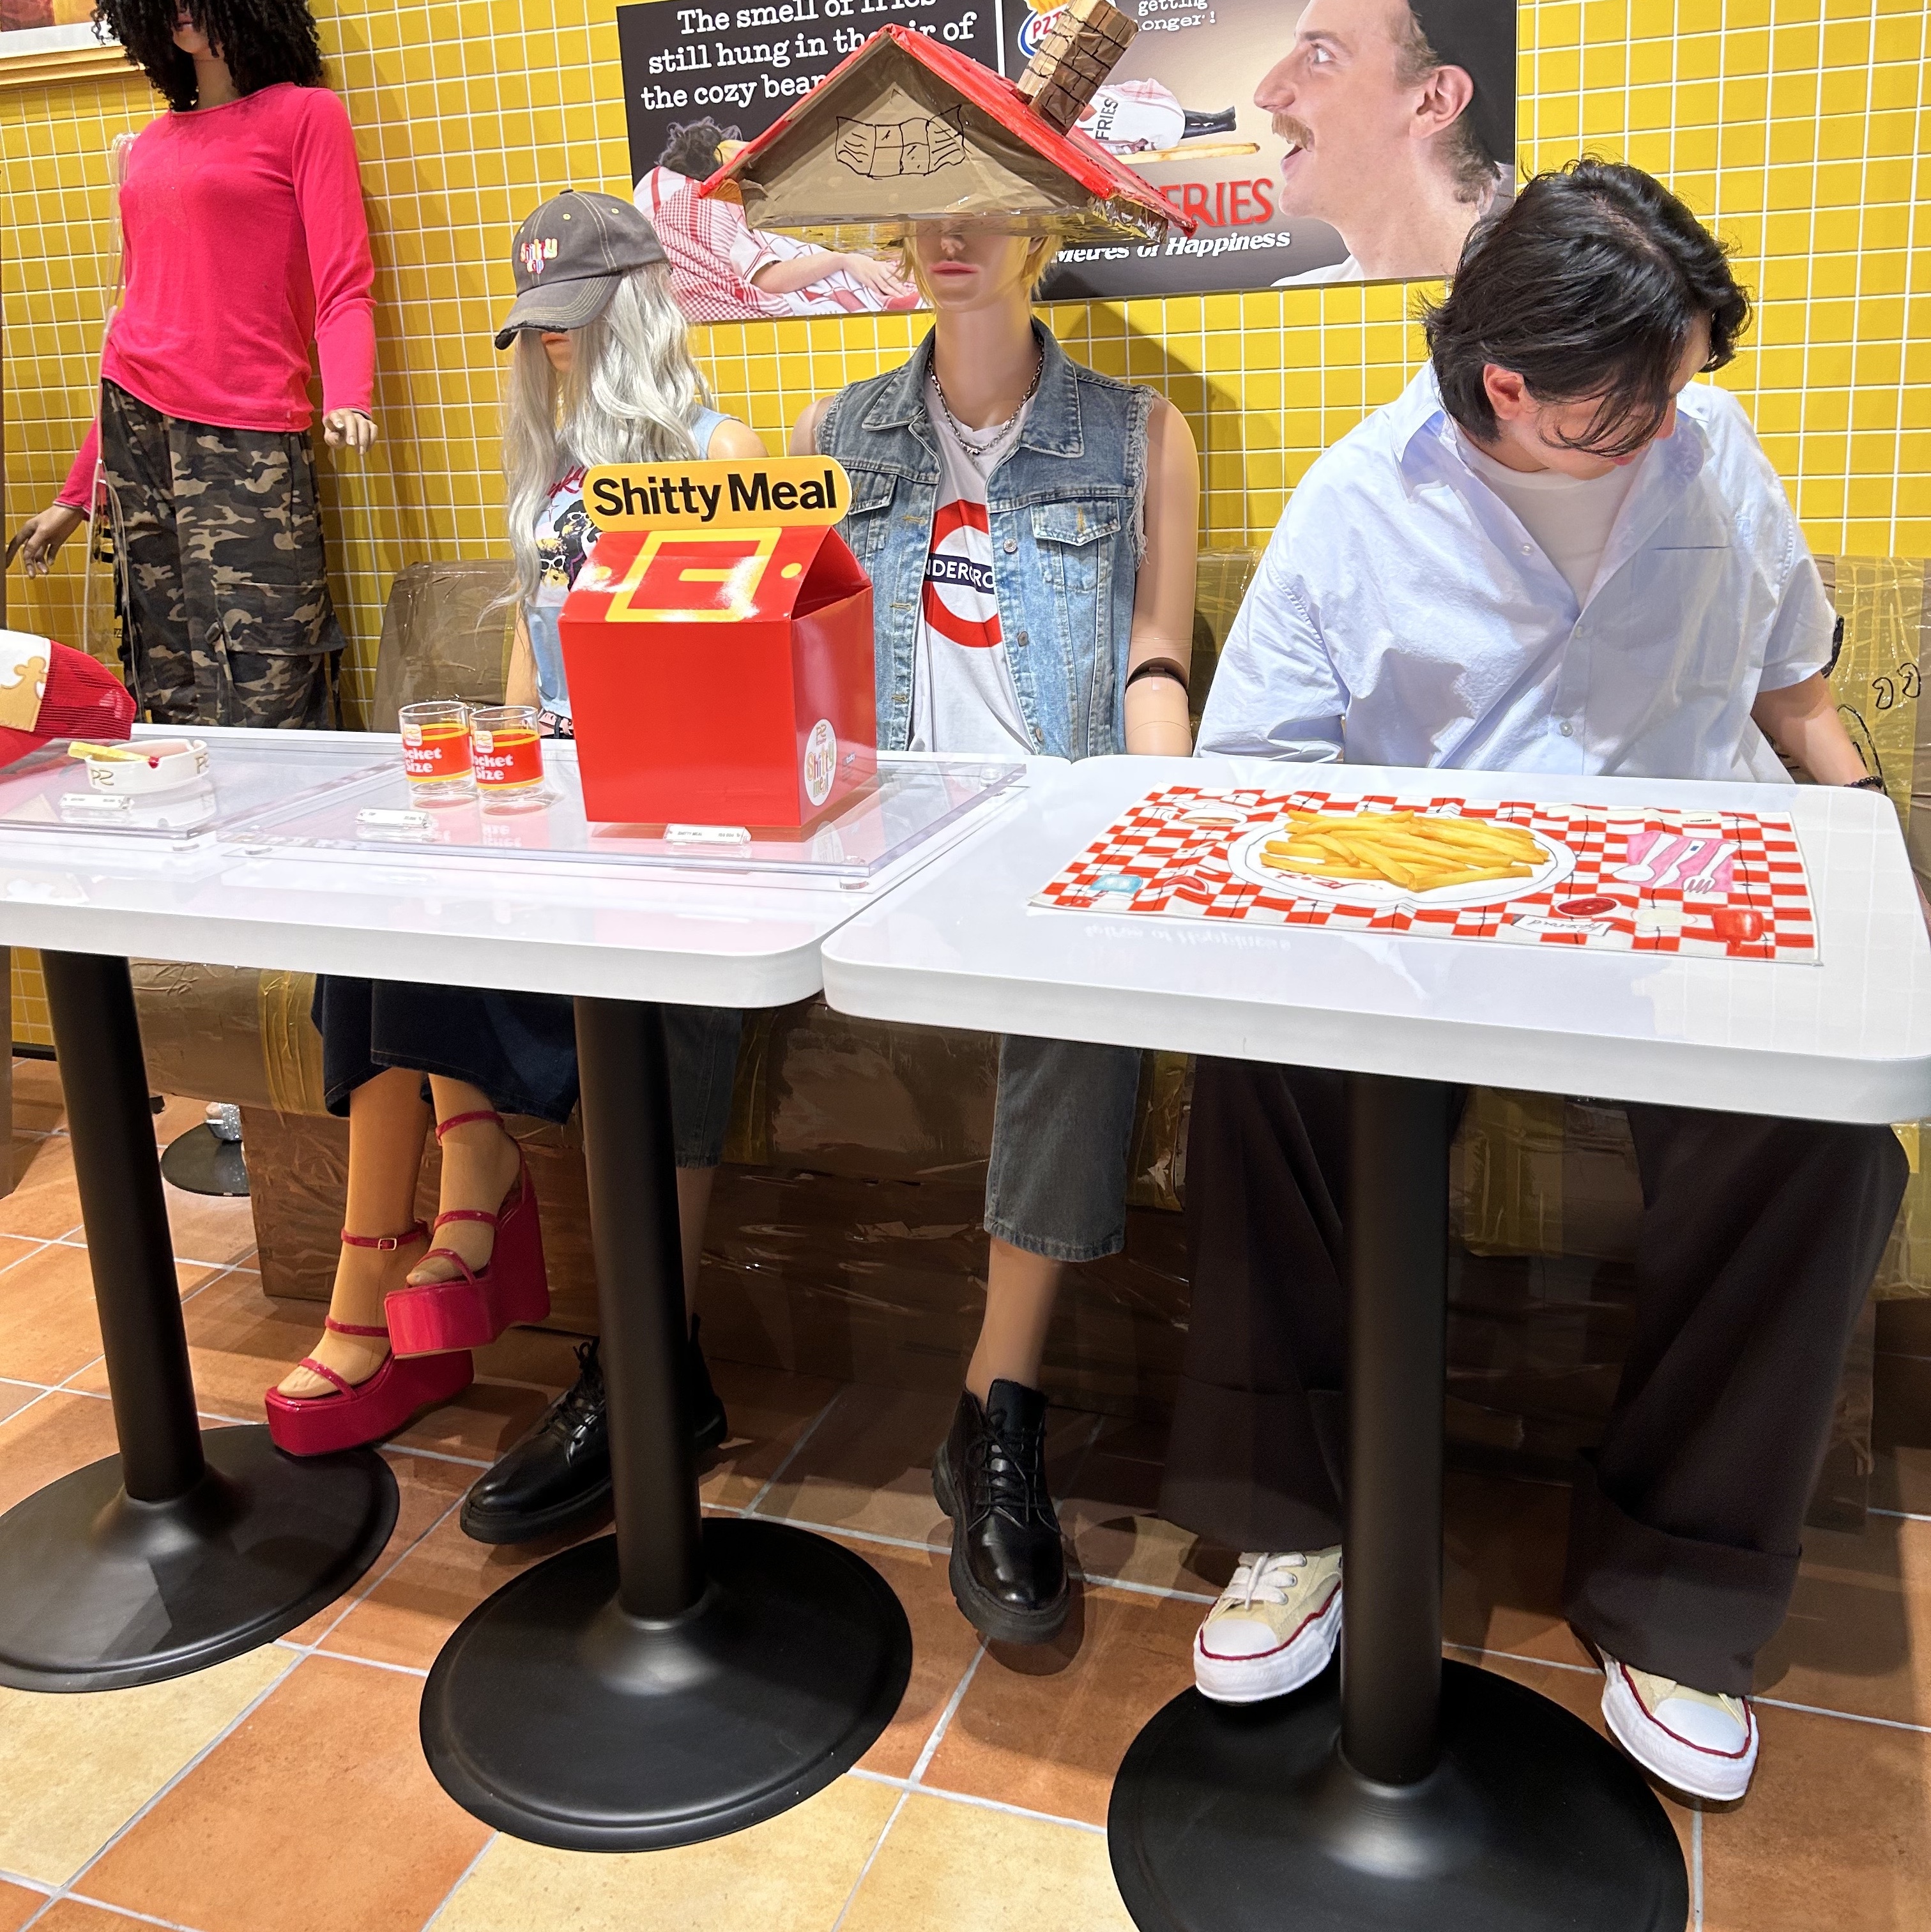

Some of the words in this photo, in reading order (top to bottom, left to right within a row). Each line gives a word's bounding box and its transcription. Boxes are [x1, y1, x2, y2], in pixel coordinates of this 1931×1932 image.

[677, 8, 730, 34] The
[736, 0, 819, 28] smell
[1137, 0, 1209, 17] getting
[1138, 13, 1206, 32] onger
[648, 44, 712, 75] still
[715, 40, 791, 68] hung
[795, 33, 828, 58] in
[943, 11, 977, 41] of
[641, 84, 688, 110] the
[694, 81, 758, 108] cozy
[1095, 97, 1118, 141] FRIES
[1164, 231, 1291, 257] Happiness
[592, 475, 722, 522] Shitty
[727, 469, 837, 512] Meal
[402, 747, 443, 761] ocket
[473, 753, 514, 768] ocket
[406, 759, 434, 773] Size
[476, 766, 505, 780] Size
